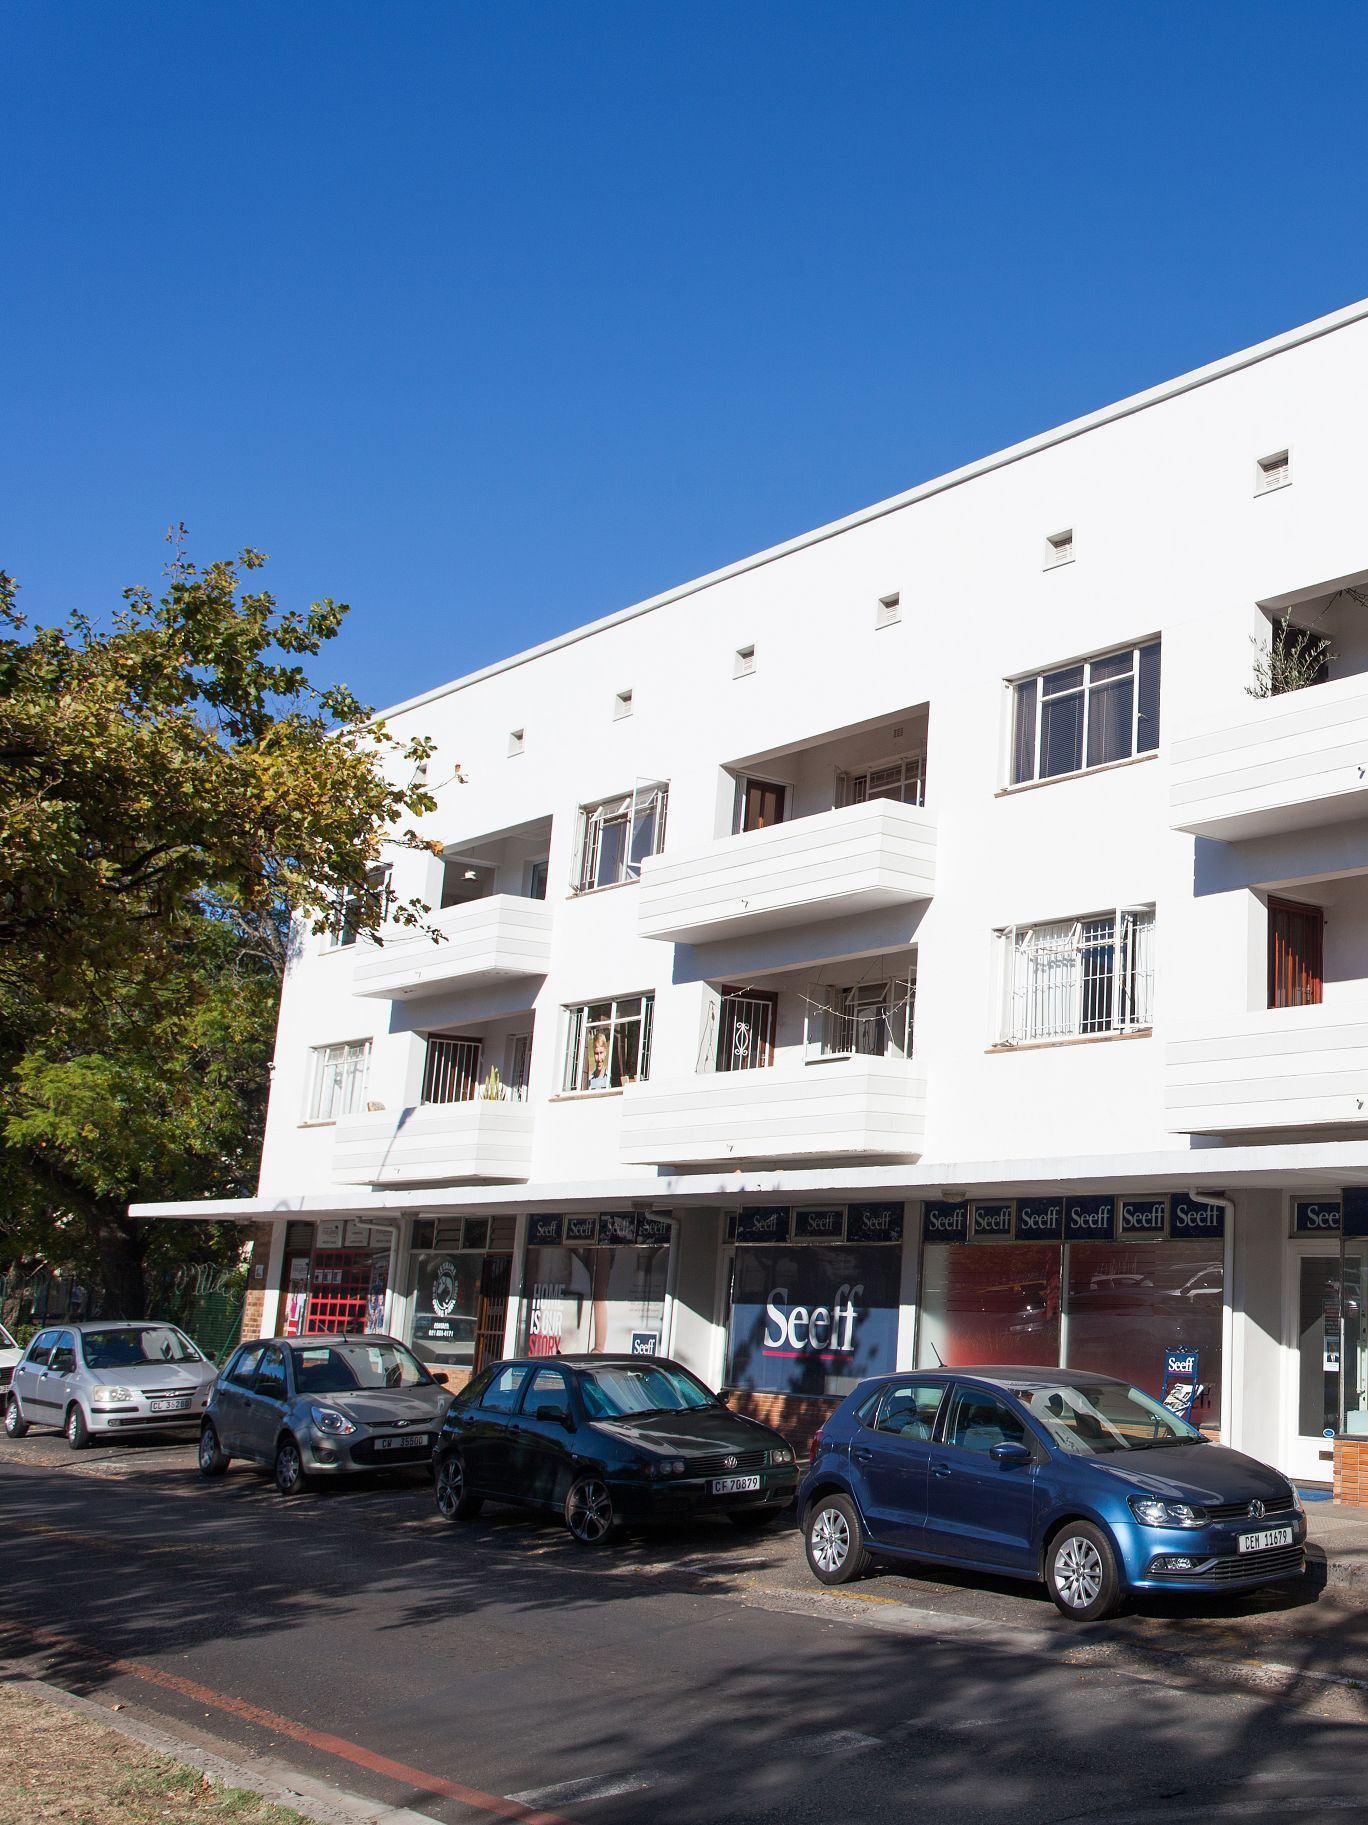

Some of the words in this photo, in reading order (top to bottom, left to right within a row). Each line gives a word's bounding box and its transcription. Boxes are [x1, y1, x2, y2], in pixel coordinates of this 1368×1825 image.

[753, 1212, 777, 1232] Seeff
[807, 1213, 835, 1231] Seeff
[862, 1211, 892, 1230] Seeff
[929, 1209, 964, 1231] Seeff
[975, 1208, 1012, 1230] Seeff
[1021, 1206, 1060, 1229] Seeff
[1070, 1205, 1110, 1229] Seeff
[1123, 1203, 1165, 1228] Seeff
[1176, 1204, 1219, 1227] Seeff
[1307, 1205, 1341, 1228] See
[536, 1220, 557, 1237] Seeff
[569, 1219, 593, 1236] Seeff
[533, 1284, 566, 1309] HOME
[530, 1310, 541, 1334] IS
[542, 1311, 563, 1335] OUR
[763, 1283, 865, 1351] Seeff
[528, 1335, 562, 1357] STORY
[634, 1339, 656, 1355] Seeff
[1168, 1356, 1195, 1372] Seeff
[153, 1402, 162, 1410] CL
[382, 1439, 392, 1448] CW
[715, 1480, 728, 1492] CF
[730, 1477, 758, 1491] 70879
[1245, 1535, 1260, 1550] CEM
[1264, 1530, 1288, 1547] 11679
